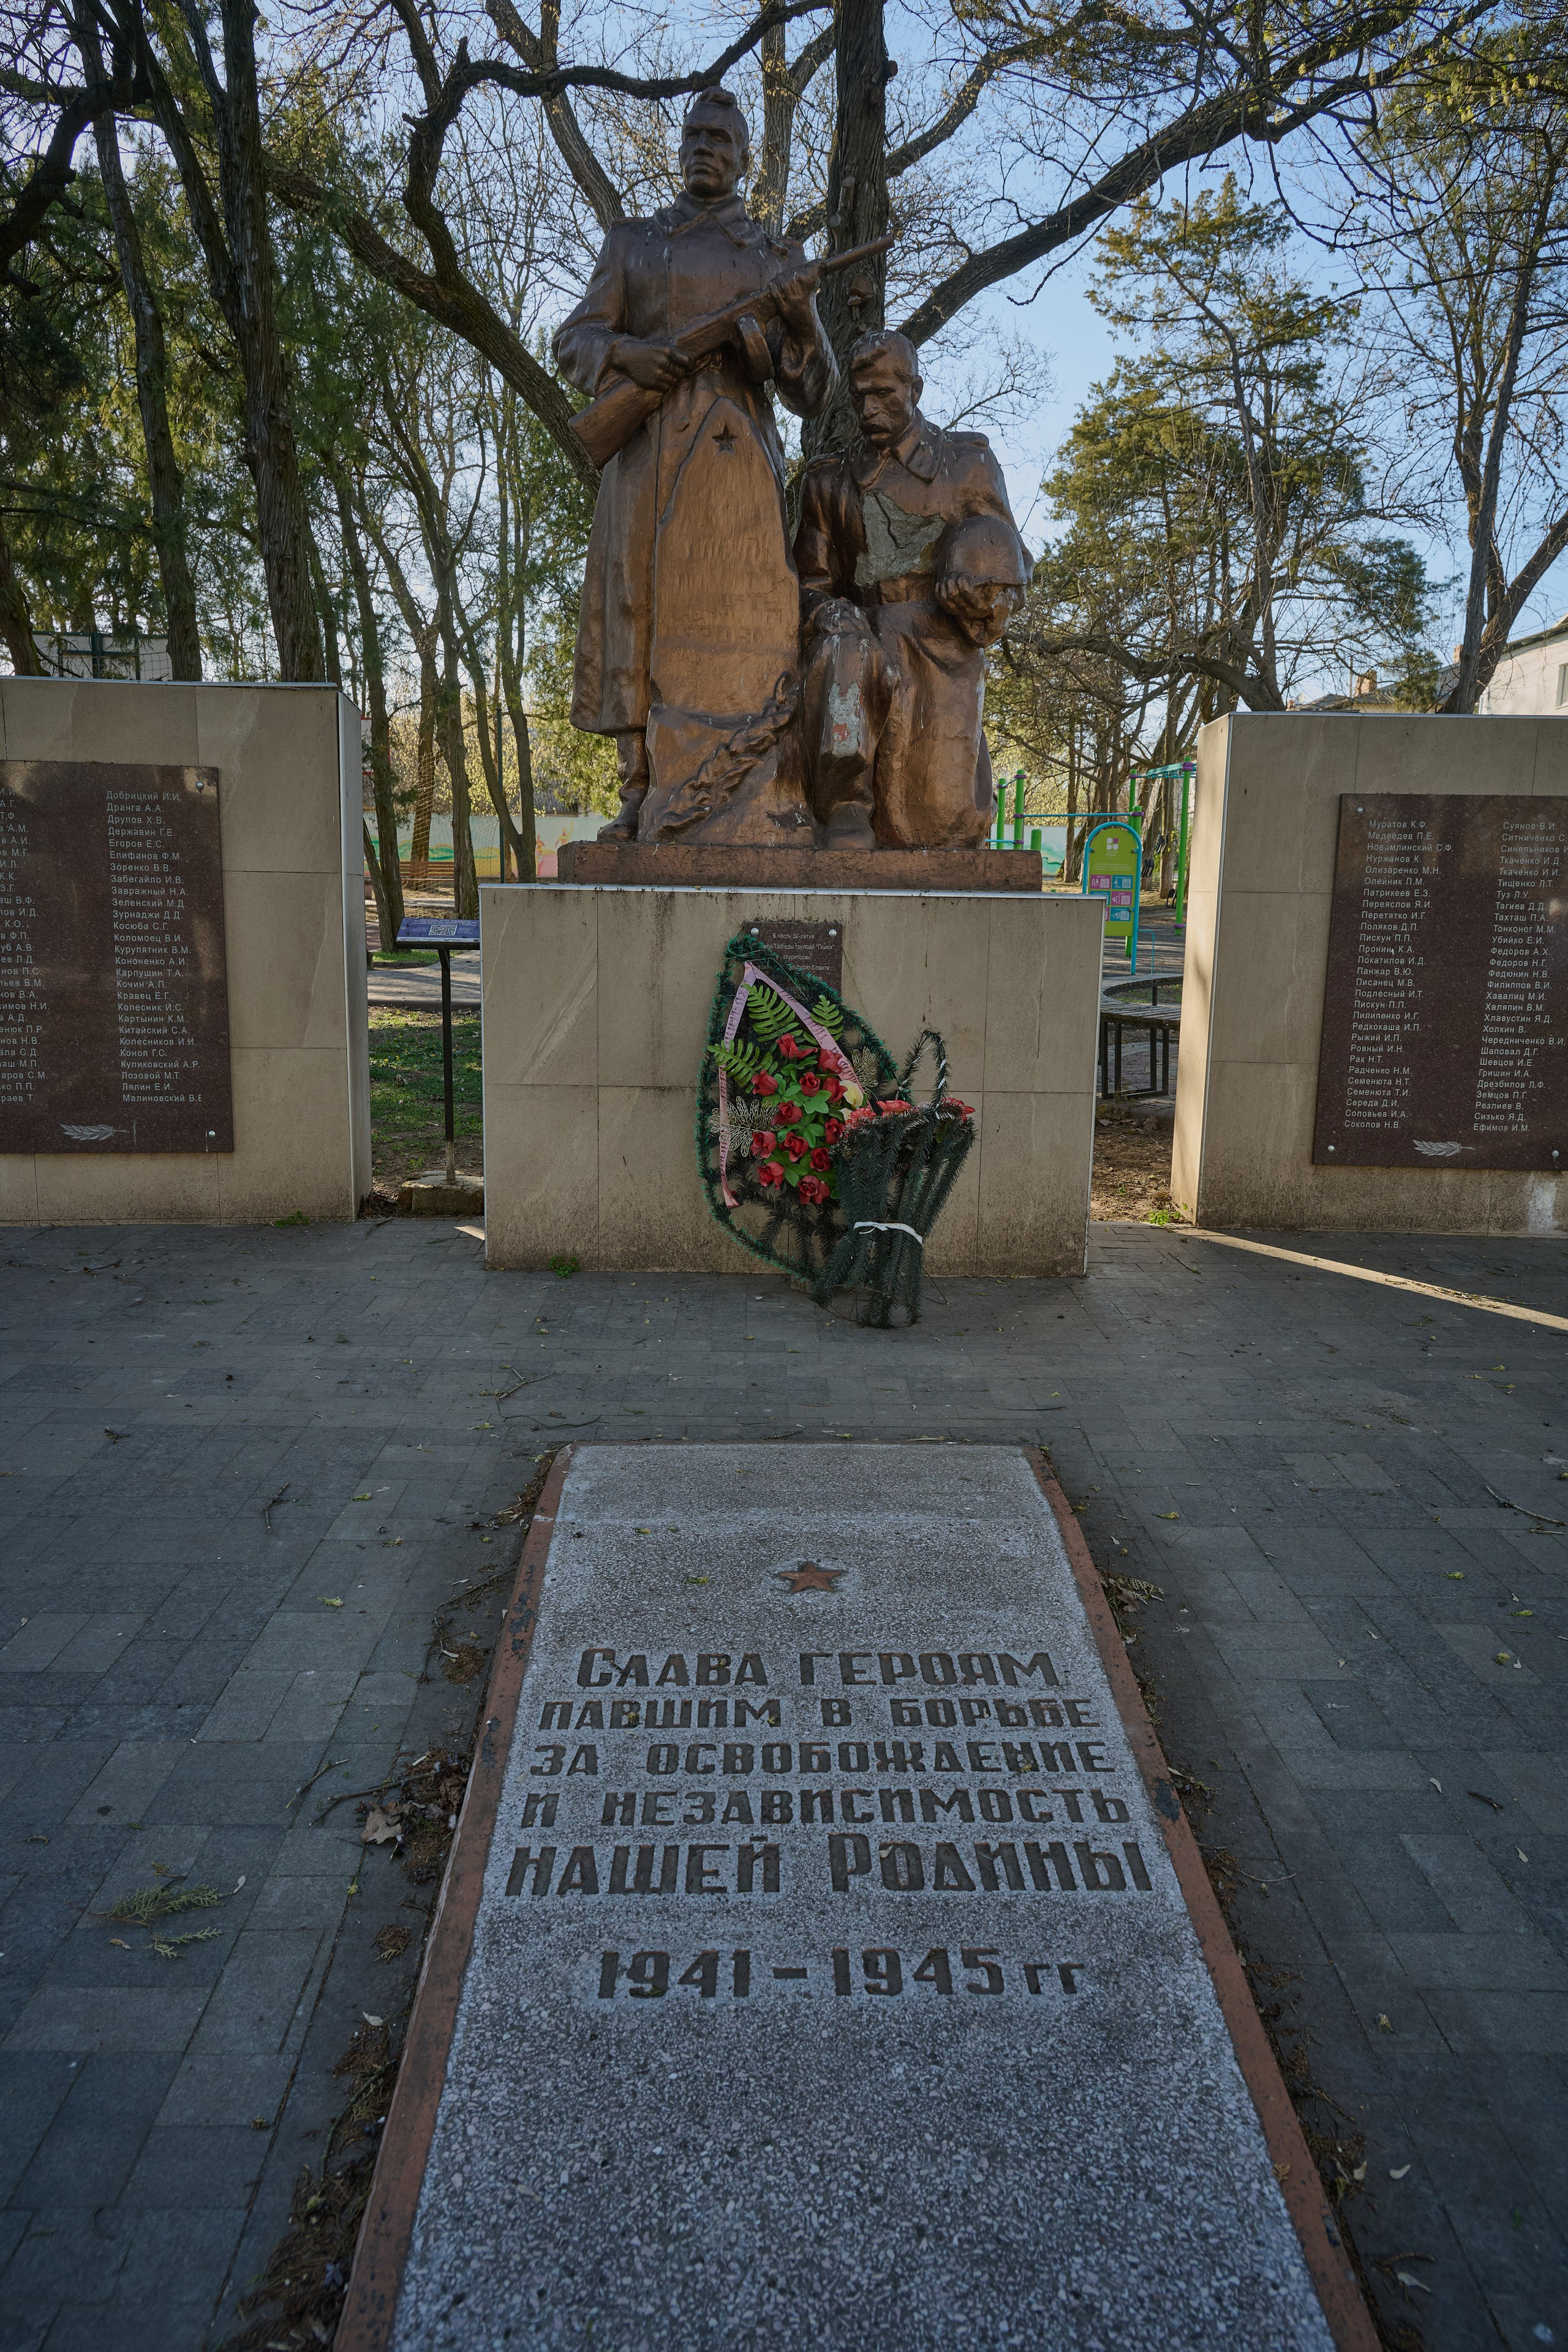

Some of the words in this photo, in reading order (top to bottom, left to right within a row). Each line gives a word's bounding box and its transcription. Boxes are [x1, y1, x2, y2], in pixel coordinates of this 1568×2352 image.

[107, 791, 158, 802] Добрицкий
[107, 803, 140, 812] Дранга
[1370, 820, 1407, 829] Муратов
[1503, 822, 1536, 831] Суянов
[108, 827, 155, 837] Державин
[11, 837, 30, 845] А.И.
[109, 839, 142, 848] Егоров
[110, 851, 158, 861] Епифанов
[1544, 857, 1561, 865] И.Д.
[110, 863, 149, 872] Зоренко
[1365, 866, 1418, 875] Олизаренко
[1498, 879, 1535, 888] Тищенко
[111, 887, 165, 895] Завражный
[1363, 889, 1410, 897] Патрикеев
[167, 900, 187, 908] М.Д.
[1362, 900, 1411, 908] Переяслов
[19, 908, 39, 918] И.Д.
[113, 911, 159, 919] Зурнаджи
[164, 911, 183, 920] Д.Д.
[1362, 911, 1408, 920] Перетятко
[1360, 922, 1397, 931] Поляков
[1401, 923, 1419, 932] Д.П.
[10, 932, 30, 940] Ф.П.
[114, 934, 160, 943] Коломоец
[1490, 959, 1528, 967] Федоров
[116, 969, 162, 978] Карпушин
[1355, 989, 1405, 998] Подлесный
[1354, 1000, 1385, 1009] Пискун
[8, 1014, 27, 1022] А.Д.
[1352, 1011, 1400, 1020] Пилипенко
[1482, 1036, 1545, 1044] Чередниченко
[1480, 1058, 1513, 1067] Шевцов
[1479, 1069, 1510, 1077] Гришин
[1477, 1091, 1509, 1099] Земцов
[1473, 1123, 1508, 1132] Ефимов
[799, 1653, 1061, 1687] ГЕРОЯМ
[537, 1699, 780, 1731] ПАВШИМ
[821, 1699, 851, 1727] В
[891, 1698, 1099, 1728] БОРЬБЕ
[530, 1743, 597, 1776] ЗА
[646, 1741, 1115, 1774] ОСВОБОЖДЕНИЕ
[521, 1792, 557, 1828] И
[603, 1789, 1131, 1827] НЕЗАВИСИМОСТЬ
[505, 1836, 780, 1897] НАШЕЙ
